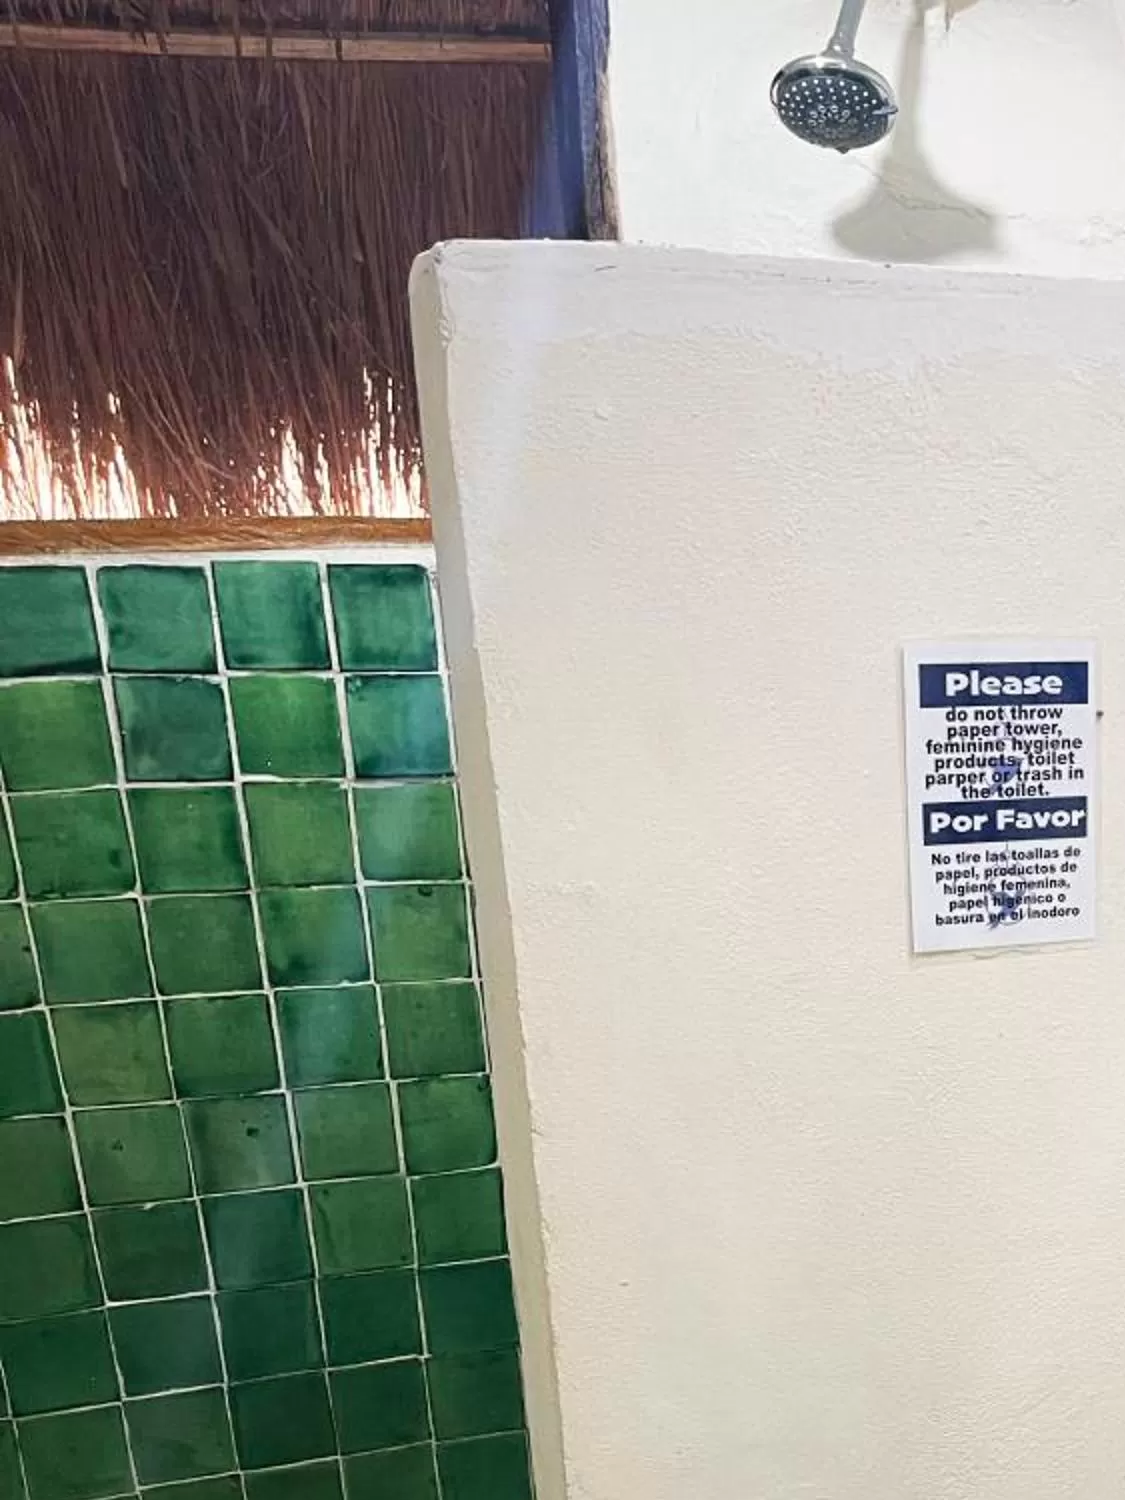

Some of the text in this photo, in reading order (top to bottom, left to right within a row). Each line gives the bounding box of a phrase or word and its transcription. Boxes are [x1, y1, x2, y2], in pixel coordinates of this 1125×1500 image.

[945, 670, 1063, 696] Please
[945, 706, 1063, 721] do not throw
[947, 723, 1062, 740] paper tower,
[926, 738, 1083, 754] feminine hygiene
[1028, 751, 1075, 766] toilet
[925, 767, 1084, 790] parper or trash in
[961, 783, 1049, 799] the toilet.
[930, 808, 1086, 833] Por Favor
[931, 846, 1081, 865] No tire las toallas de
[935, 861, 1077, 883] papel, productos de
[943, 877, 1070, 897] higiene femenina,
[949, 896, 988, 912] papel
[1057, 893, 1067, 903] o
[935, 906, 1080, 926] basura en el inodoro
